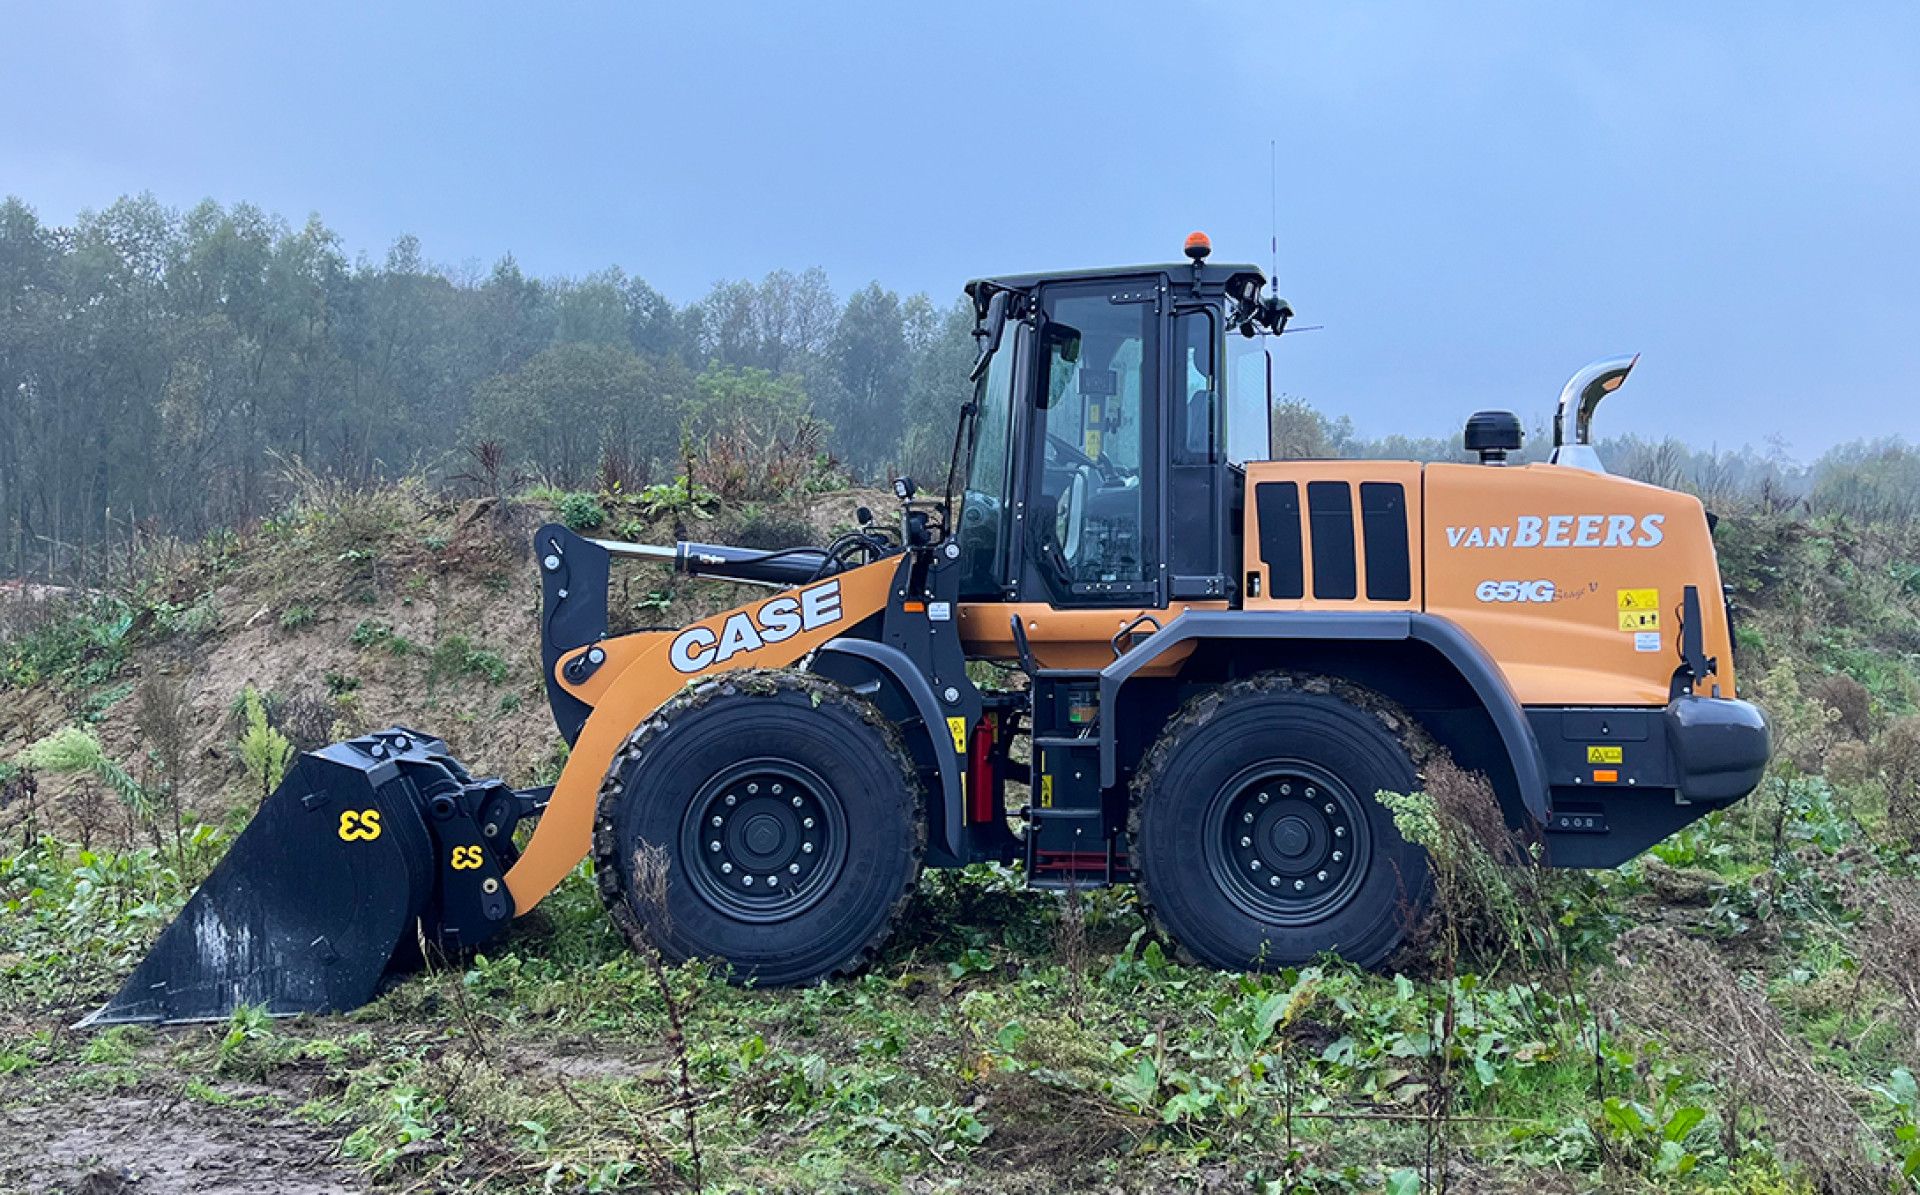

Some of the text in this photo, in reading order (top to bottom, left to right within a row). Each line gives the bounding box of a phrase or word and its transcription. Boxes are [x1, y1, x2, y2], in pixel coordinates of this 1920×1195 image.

[1446, 513, 1666, 548] VAN BEERS
[1475, 580, 1556, 603] 651G
[669, 578, 843, 673] CASE
